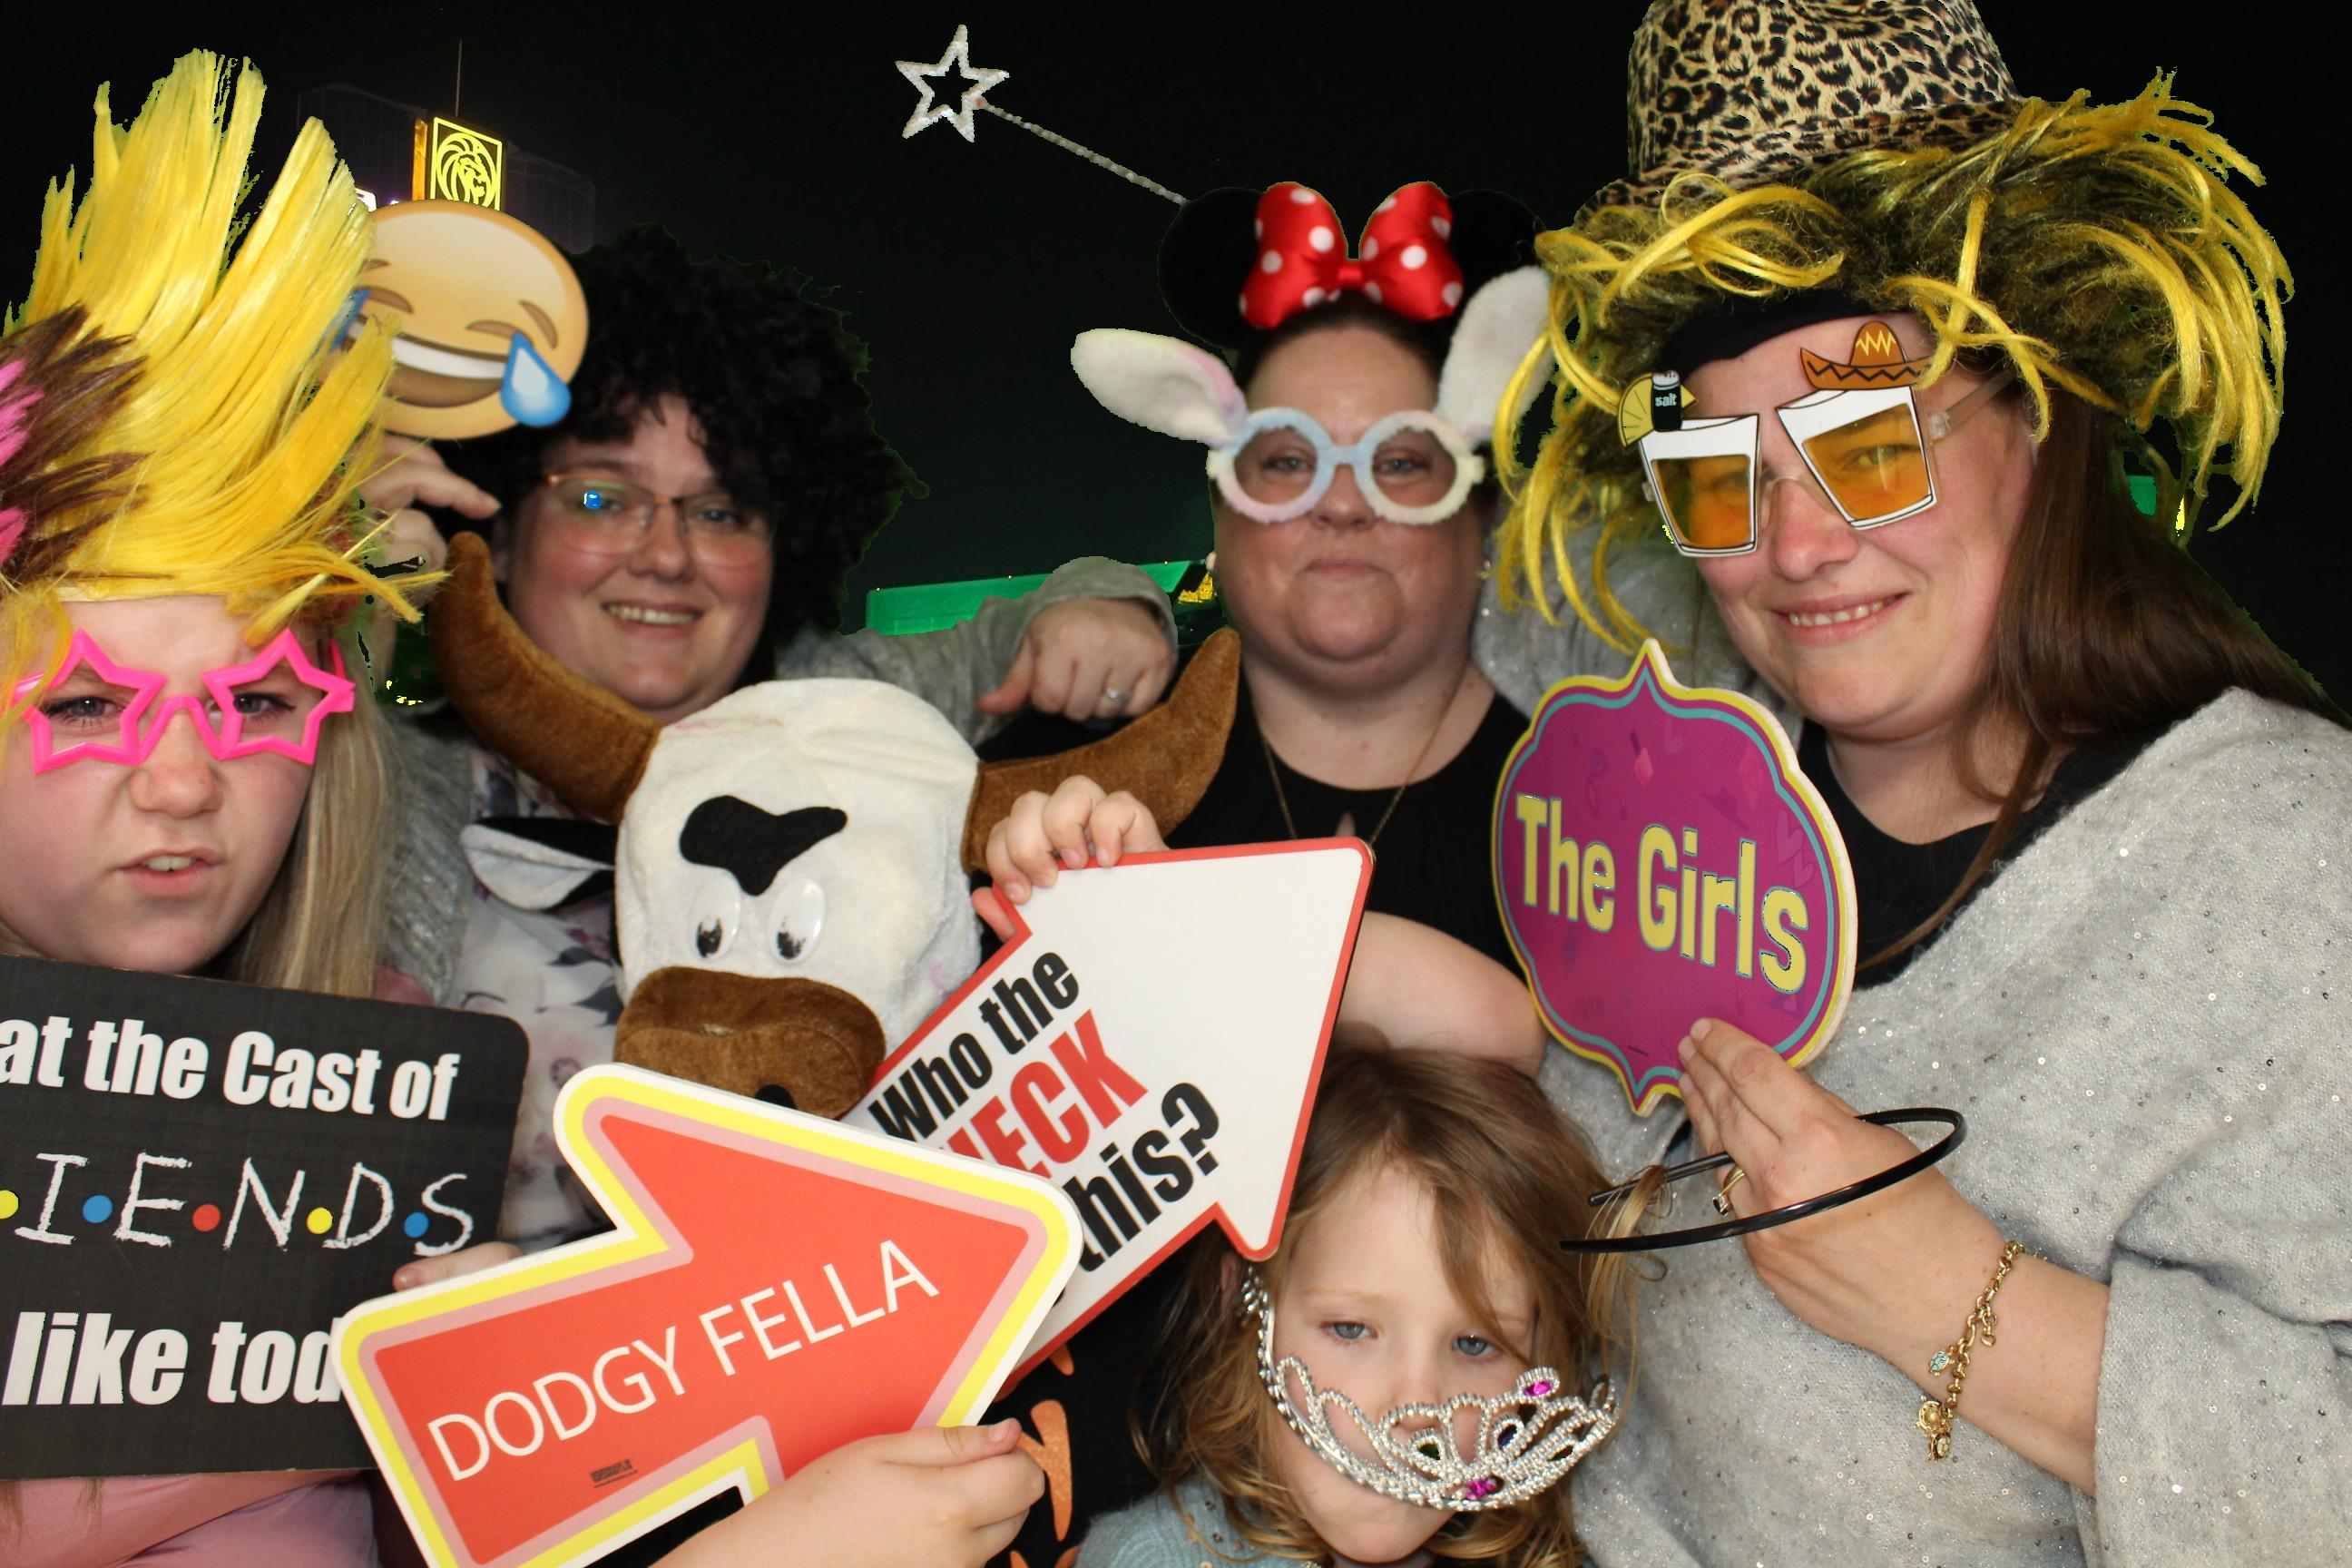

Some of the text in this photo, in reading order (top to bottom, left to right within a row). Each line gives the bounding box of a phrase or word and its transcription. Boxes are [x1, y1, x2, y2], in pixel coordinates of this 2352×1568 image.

[1654, 392, 1677, 407] salt
[1515, 792, 1809, 995] The Girls
[84, 1018, 209, 1100] the
[222, 1030, 381, 1115] Cast
[388, 1054, 461, 1122] of
[867, 952, 1079, 1142] Who the
[939, 1009, 1150, 1179] ECK
[1, 1311, 189, 1406] like
[427, 1240, 940, 1481] DODGY FELLA
